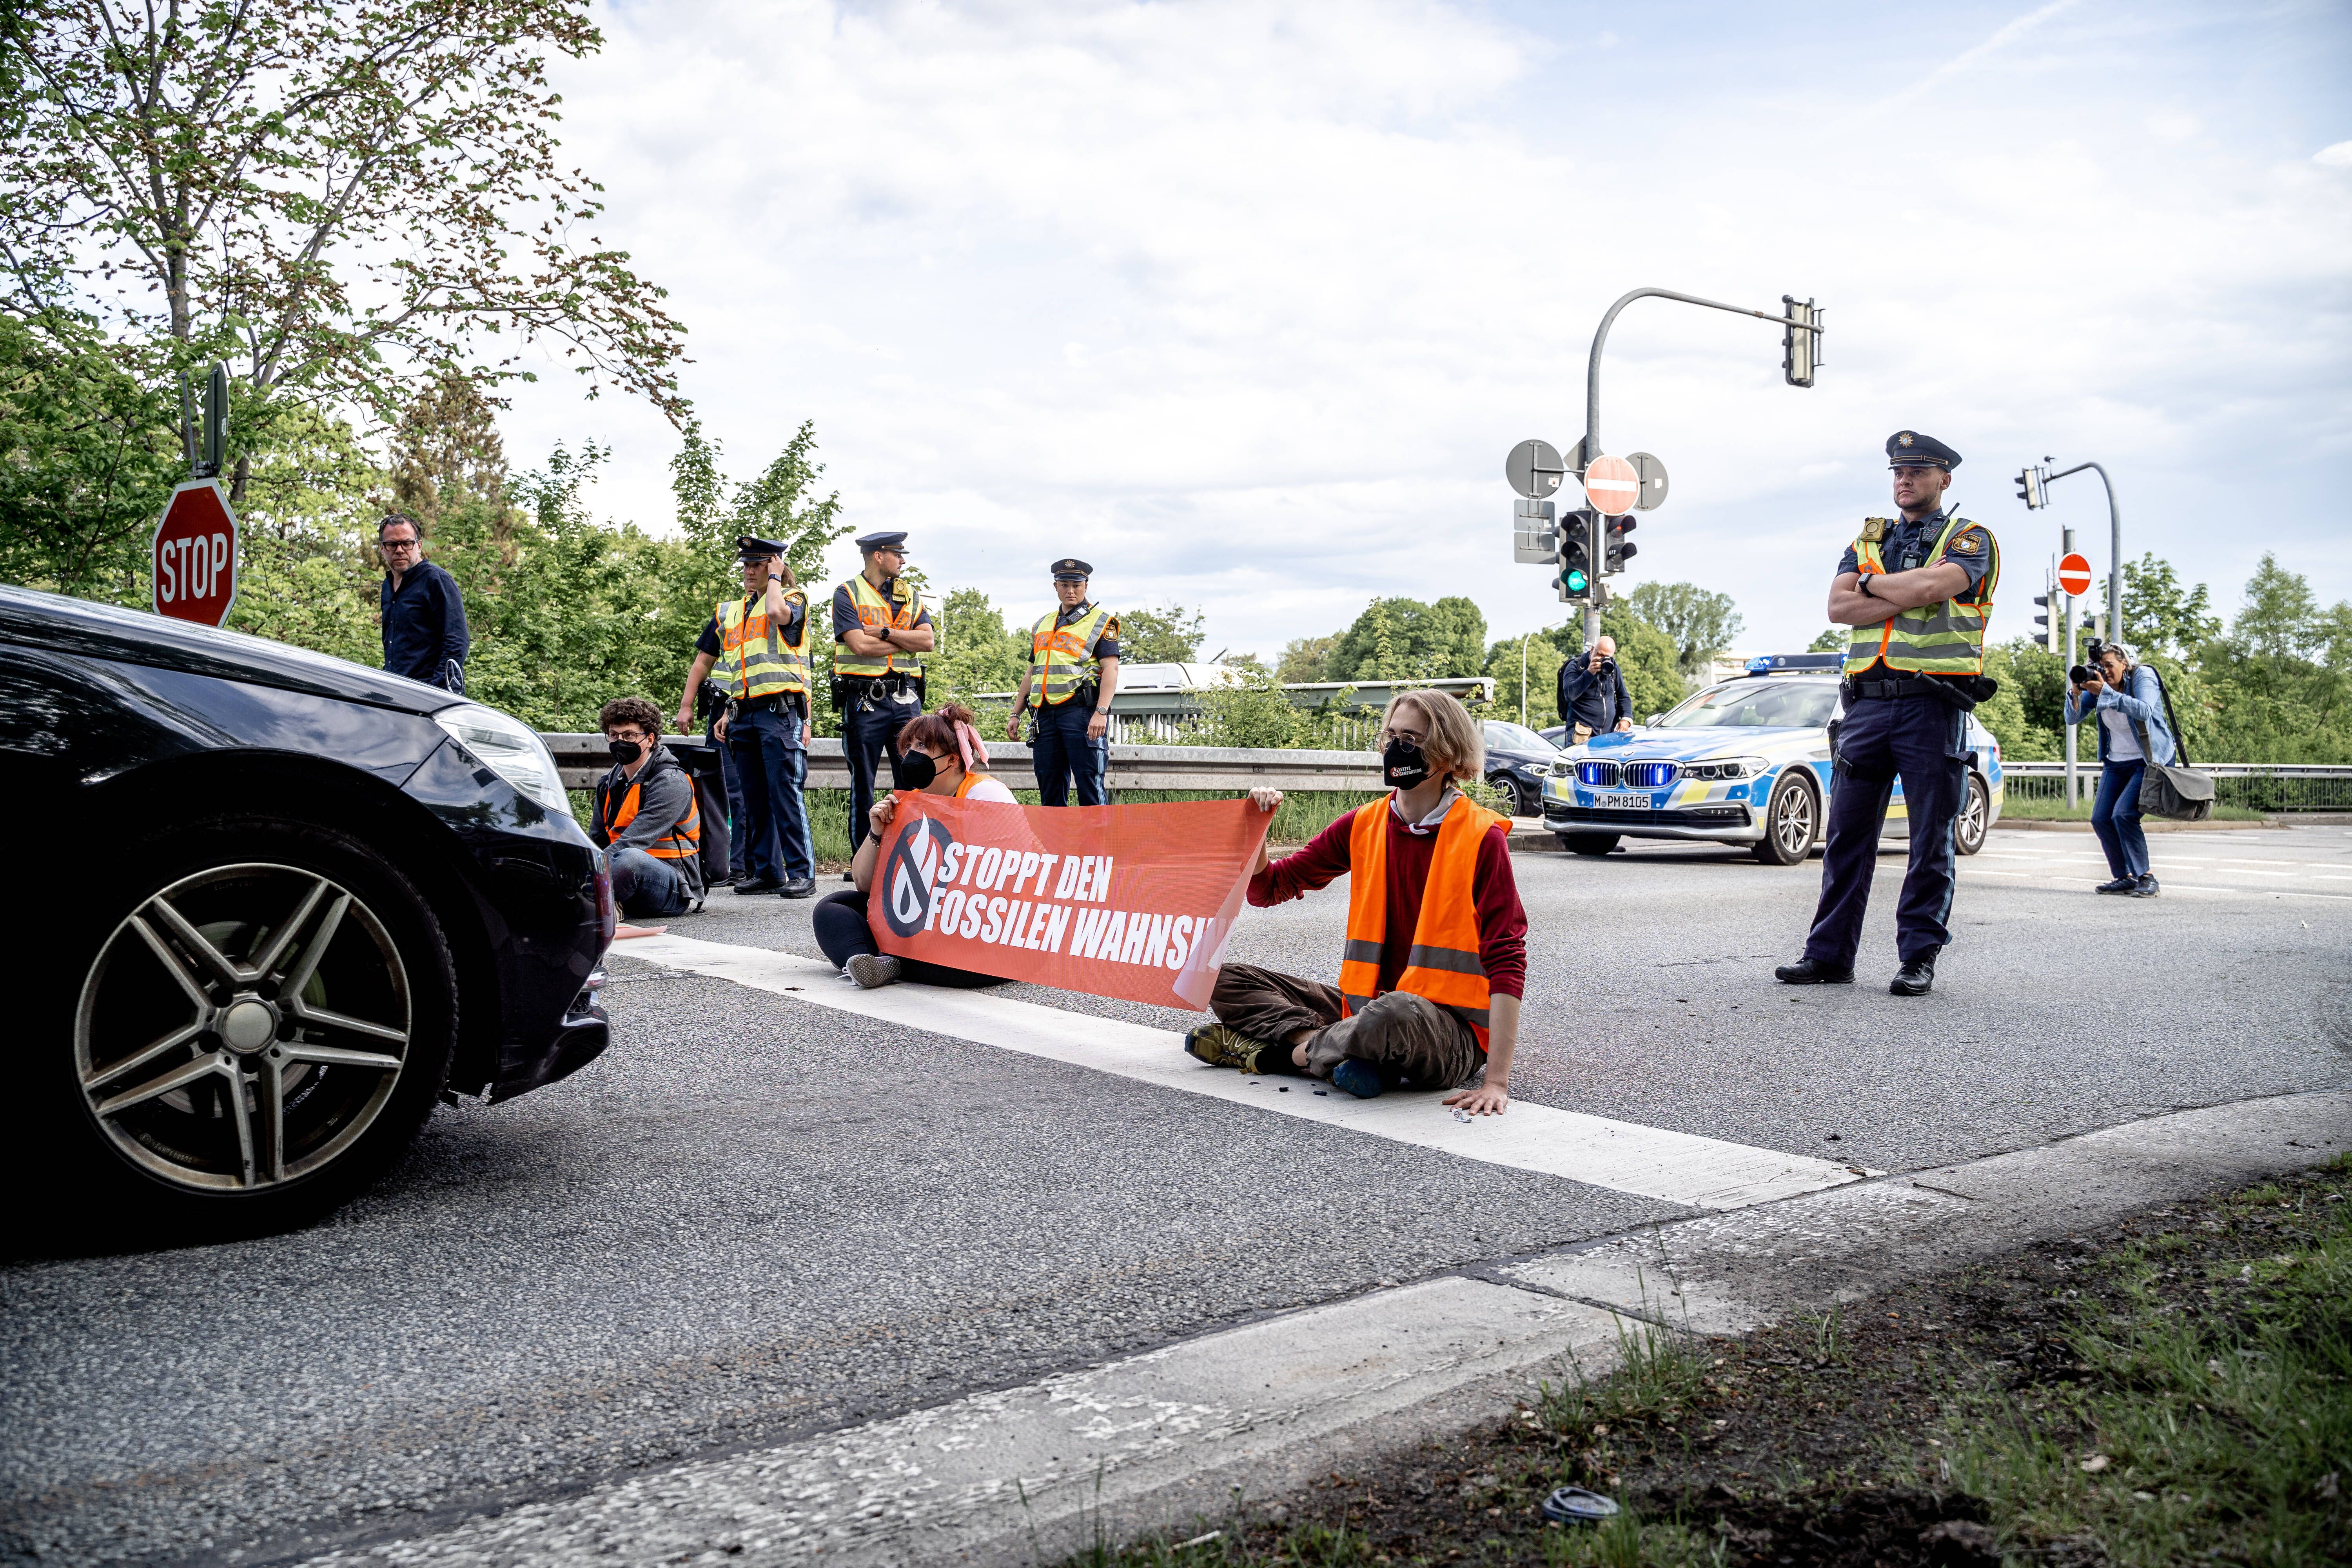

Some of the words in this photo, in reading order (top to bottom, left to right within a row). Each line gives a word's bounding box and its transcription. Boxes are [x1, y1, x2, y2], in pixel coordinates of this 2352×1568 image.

[161, 533, 227, 603] STOP
[1595, 795, 1601, 806] M
[1608, 796, 1620, 807] PM
[1622, 796, 1649, 808] 8105
[938, 842, 1059, 897] STOPPT
[1054, 855, 1113, 903] DEN
[924, 887, 1071, 953] FOSSILEN
